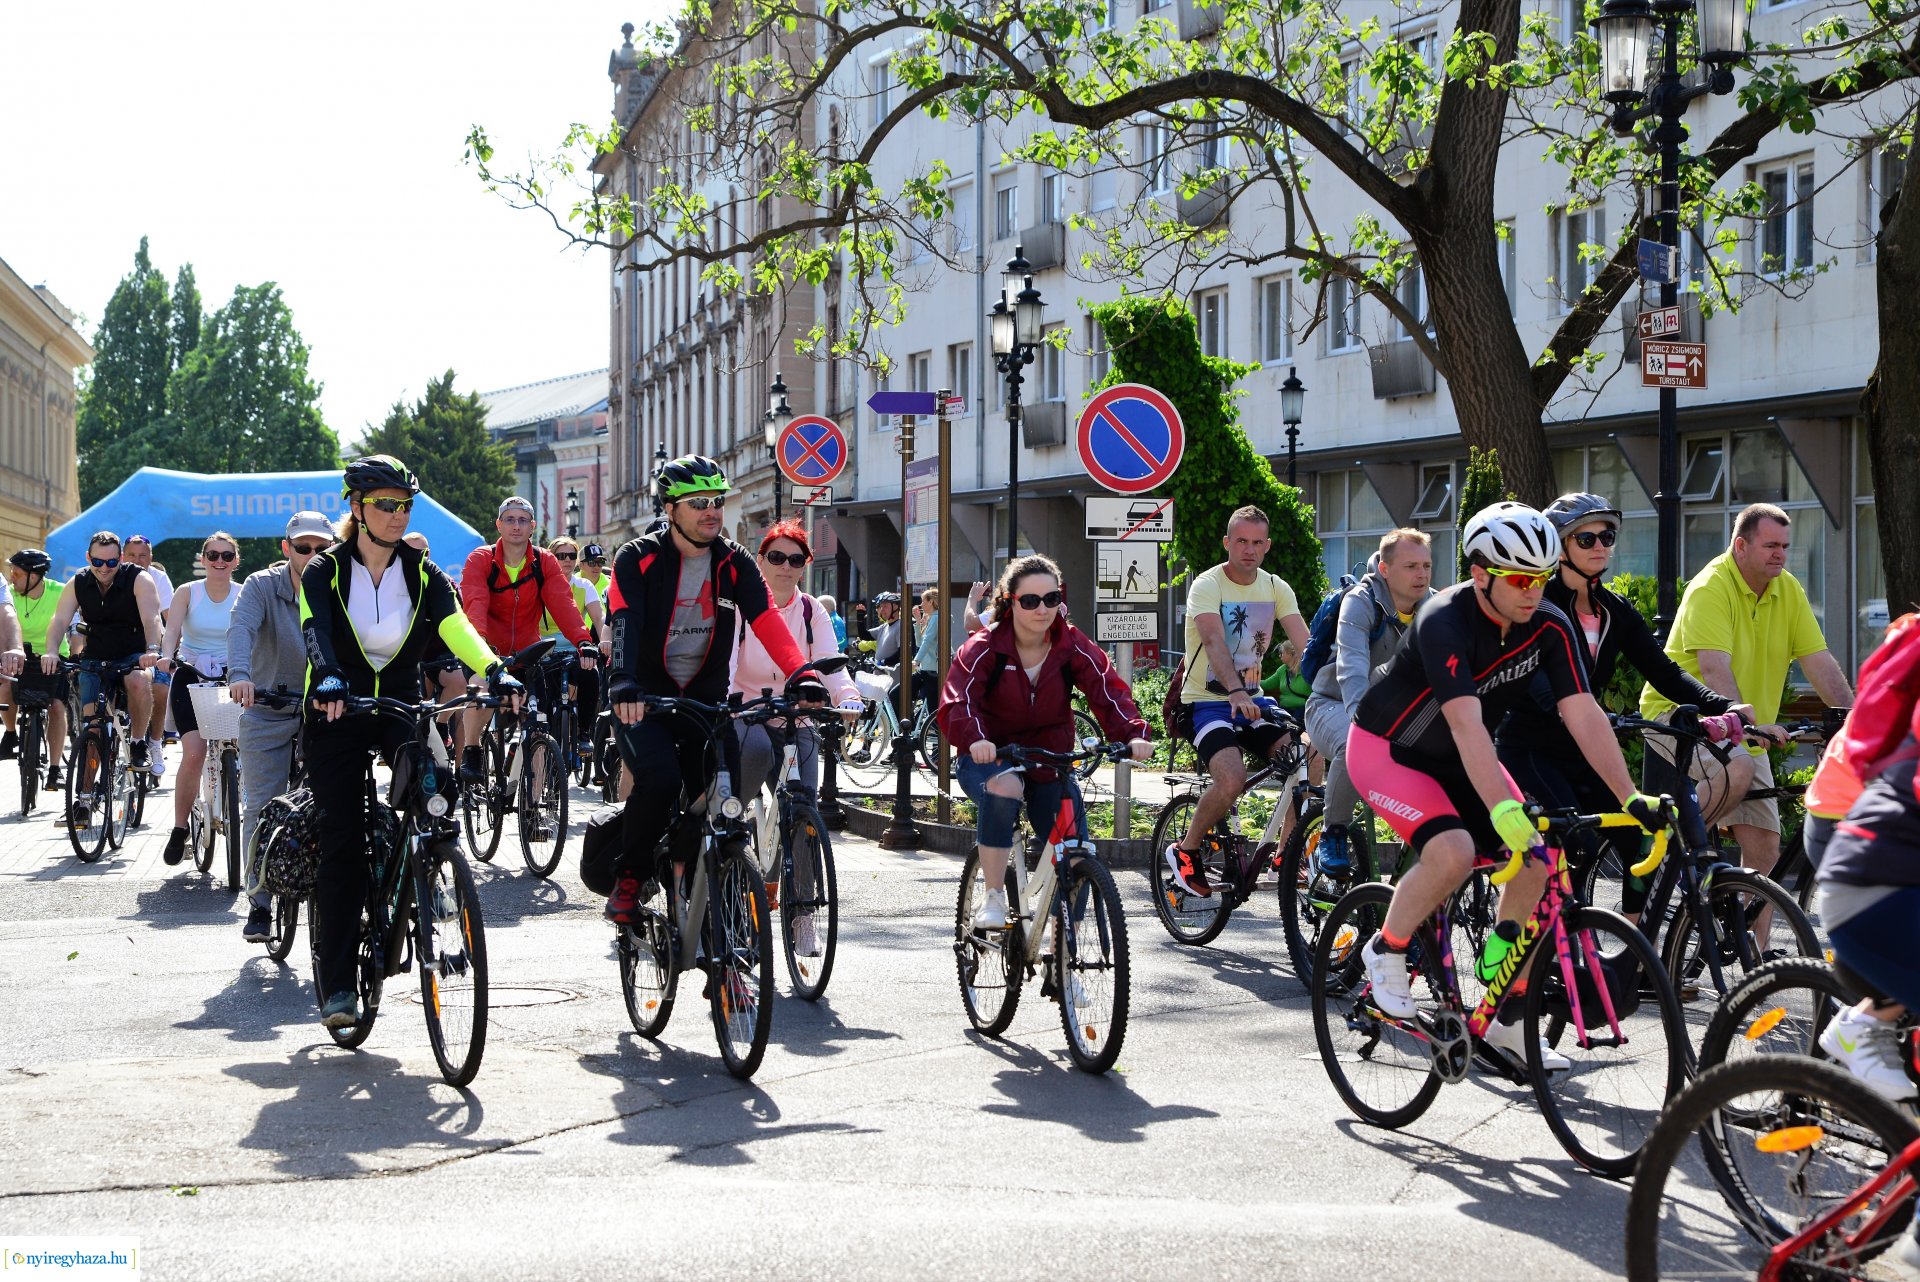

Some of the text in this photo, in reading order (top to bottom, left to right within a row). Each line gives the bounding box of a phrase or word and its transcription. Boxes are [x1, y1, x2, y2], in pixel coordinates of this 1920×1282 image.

[1647, 343, 1702, 355] MÓRICZ ZSIGMOND
[191, 492, 341, 516] SHIMANO
[1107, 614, 1148, 623] KIZÁROLAG
[613, 617, 626, 669] FORCE
[1102, 631, 1153, 639] ENGEDÉLLYEL
[1368, 790, 1424, 822] SPECIALIZED
[1639, 854, 1670, 925] TREK
[1060, 900, 1071, 930] ZOOM
[1470, 917, 1541, 1032] S-WORKS
[1727, 972, 1777, 1015] MERIDA
